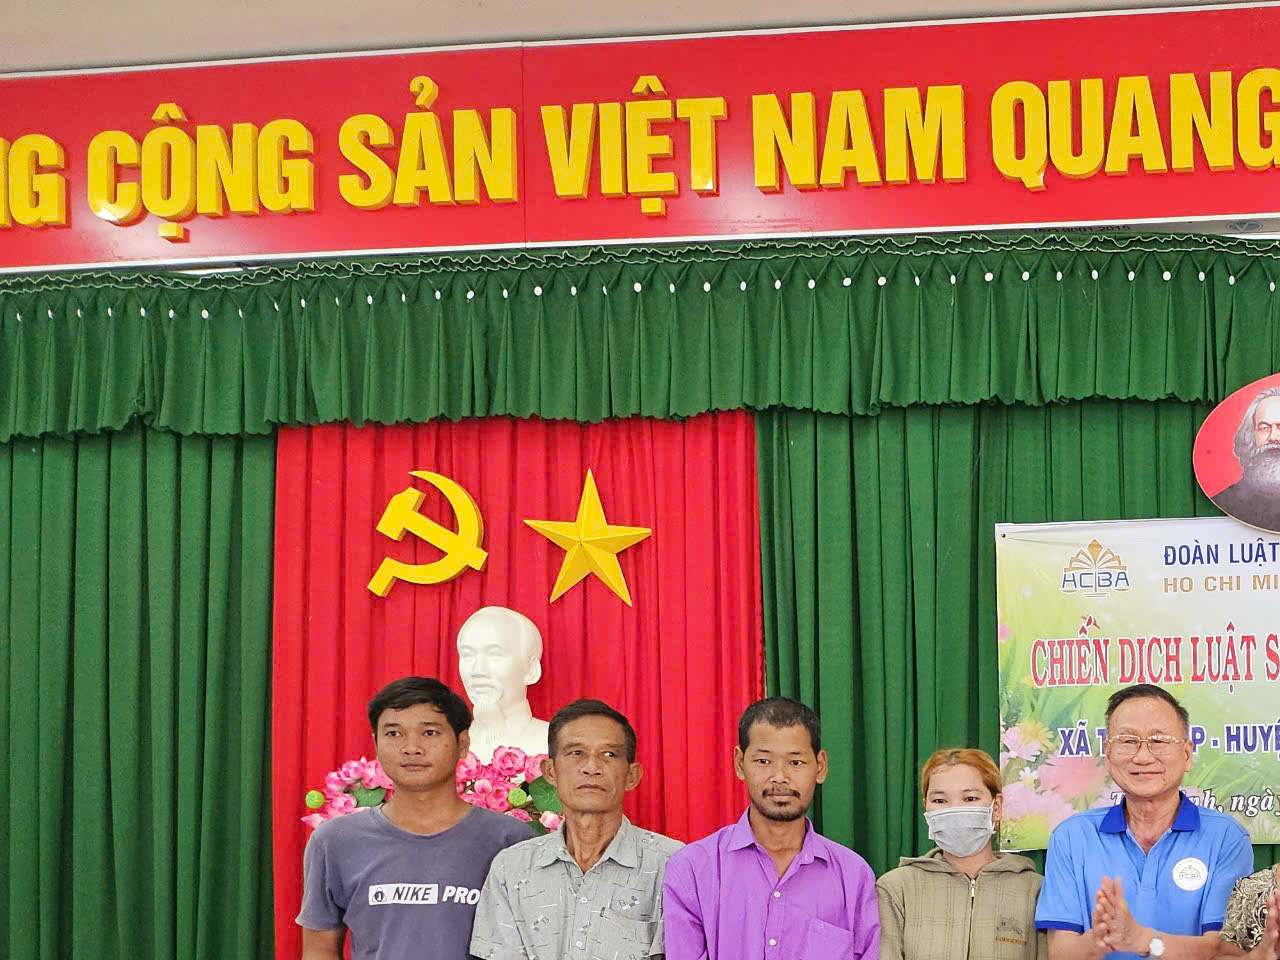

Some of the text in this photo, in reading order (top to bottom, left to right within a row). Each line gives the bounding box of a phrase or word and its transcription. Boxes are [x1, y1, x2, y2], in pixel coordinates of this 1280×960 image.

[88, 103, 314, 241] CỘNG
[339, 76, 518, 210] SẢN
[541, 75, 727, 216] VIỆT
[752, 85, 967, 193] NAM
[1164, 539, 1219, 565] ĐOÀN
[1229, 538, 1280, 566] LUẬT
[1062, 572, 1130, 588] HCBA
[1164, 577, 1193, 593] HO
[1204, 575, 1241, 591] CHI
[1031, 615, 1110, 687] CHIẾN
[1190, 621, 1256, 694] LUẬT
[1059, 720, 1091, 756] XÃ
[392, 886, 480, 904] NIKE PRO
